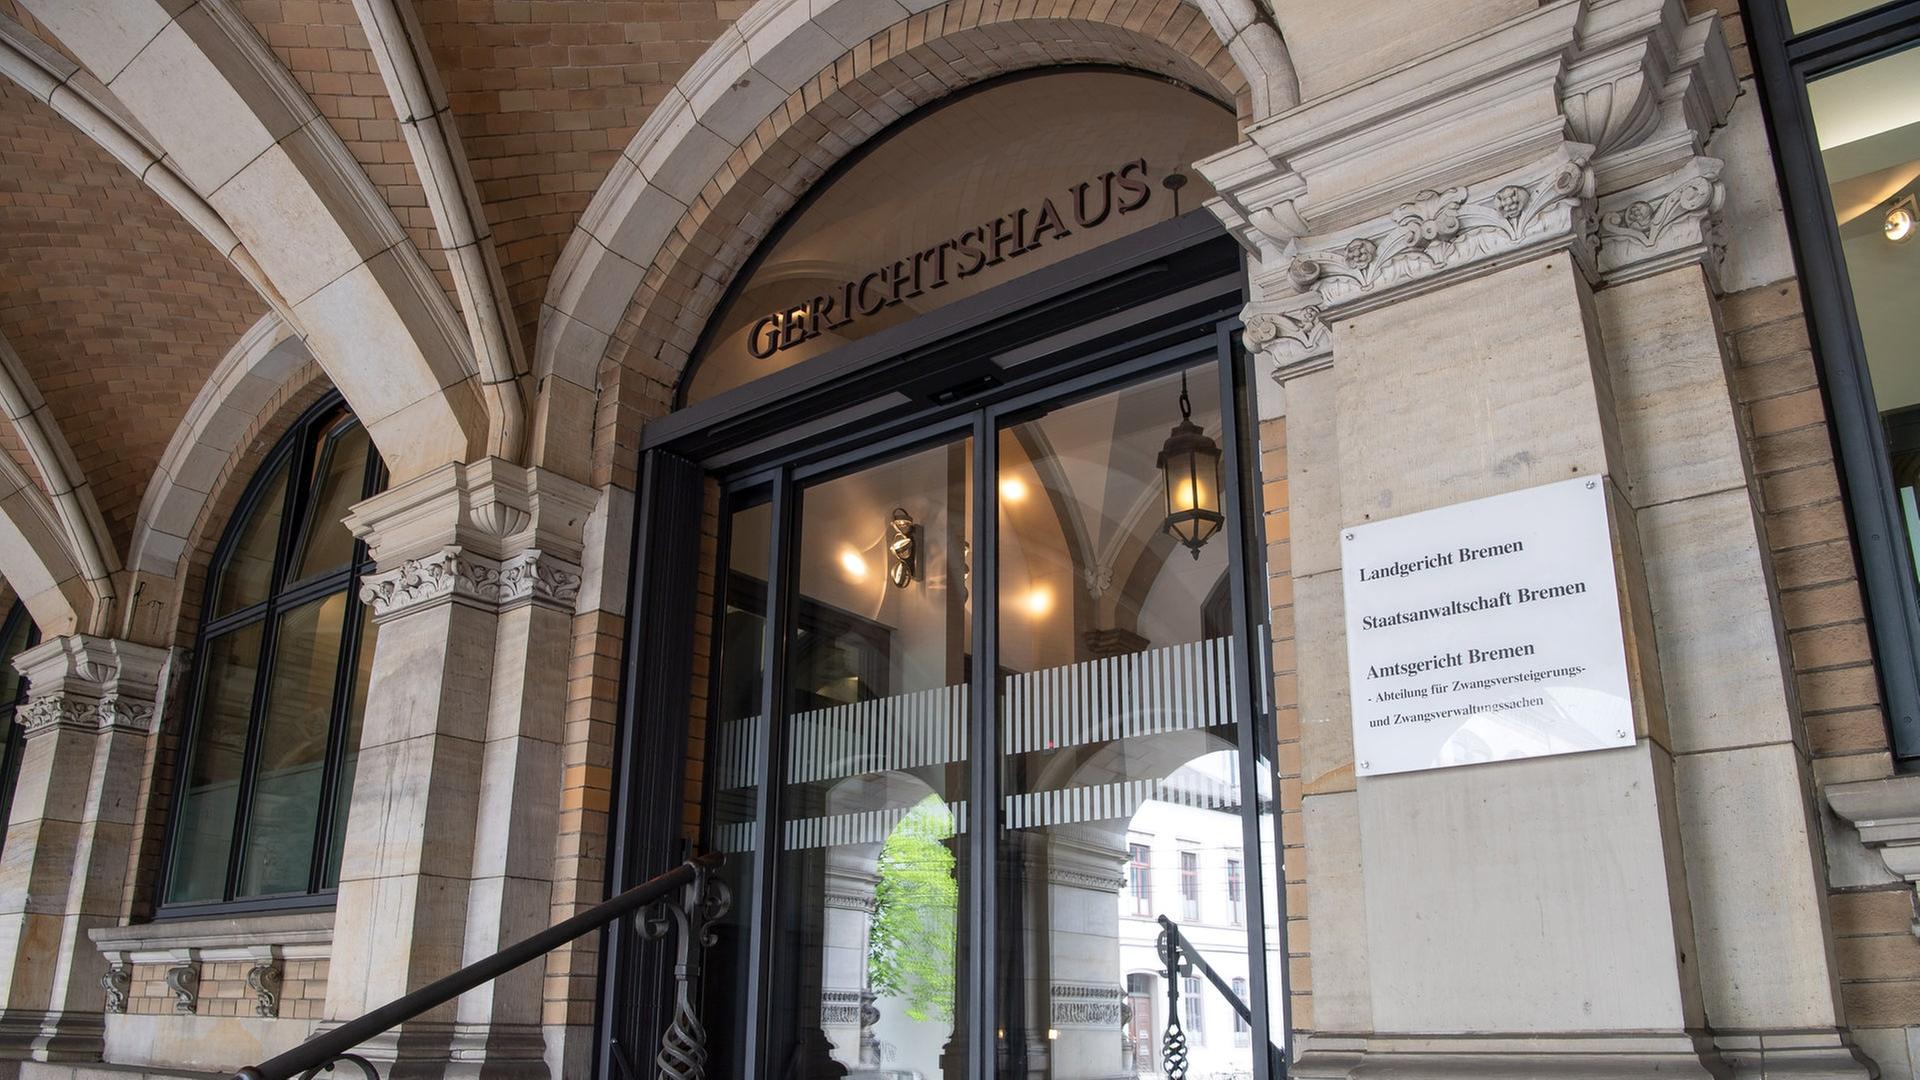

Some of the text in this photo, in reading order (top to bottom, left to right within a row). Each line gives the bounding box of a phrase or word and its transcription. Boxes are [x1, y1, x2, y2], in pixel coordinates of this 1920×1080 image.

[747, 158, 1151, 359] GERICHTSHAUS
[1359, 540, 1524, 583] Landgericht Bremen
[1362, 581, 1587, 630] Staatsanwaltschaft Bremen
[1366, 643, 1536, 680] Amtsgericht Bremen
[1375, 686, 1429, 704] Abteilung
[1430, 683, 1449, 695] für
[1452, 665, 1587, 692] Zwangsversteigerungs-
[1369, 696, 1544, 729] und Zwangsverwaltungssachen
